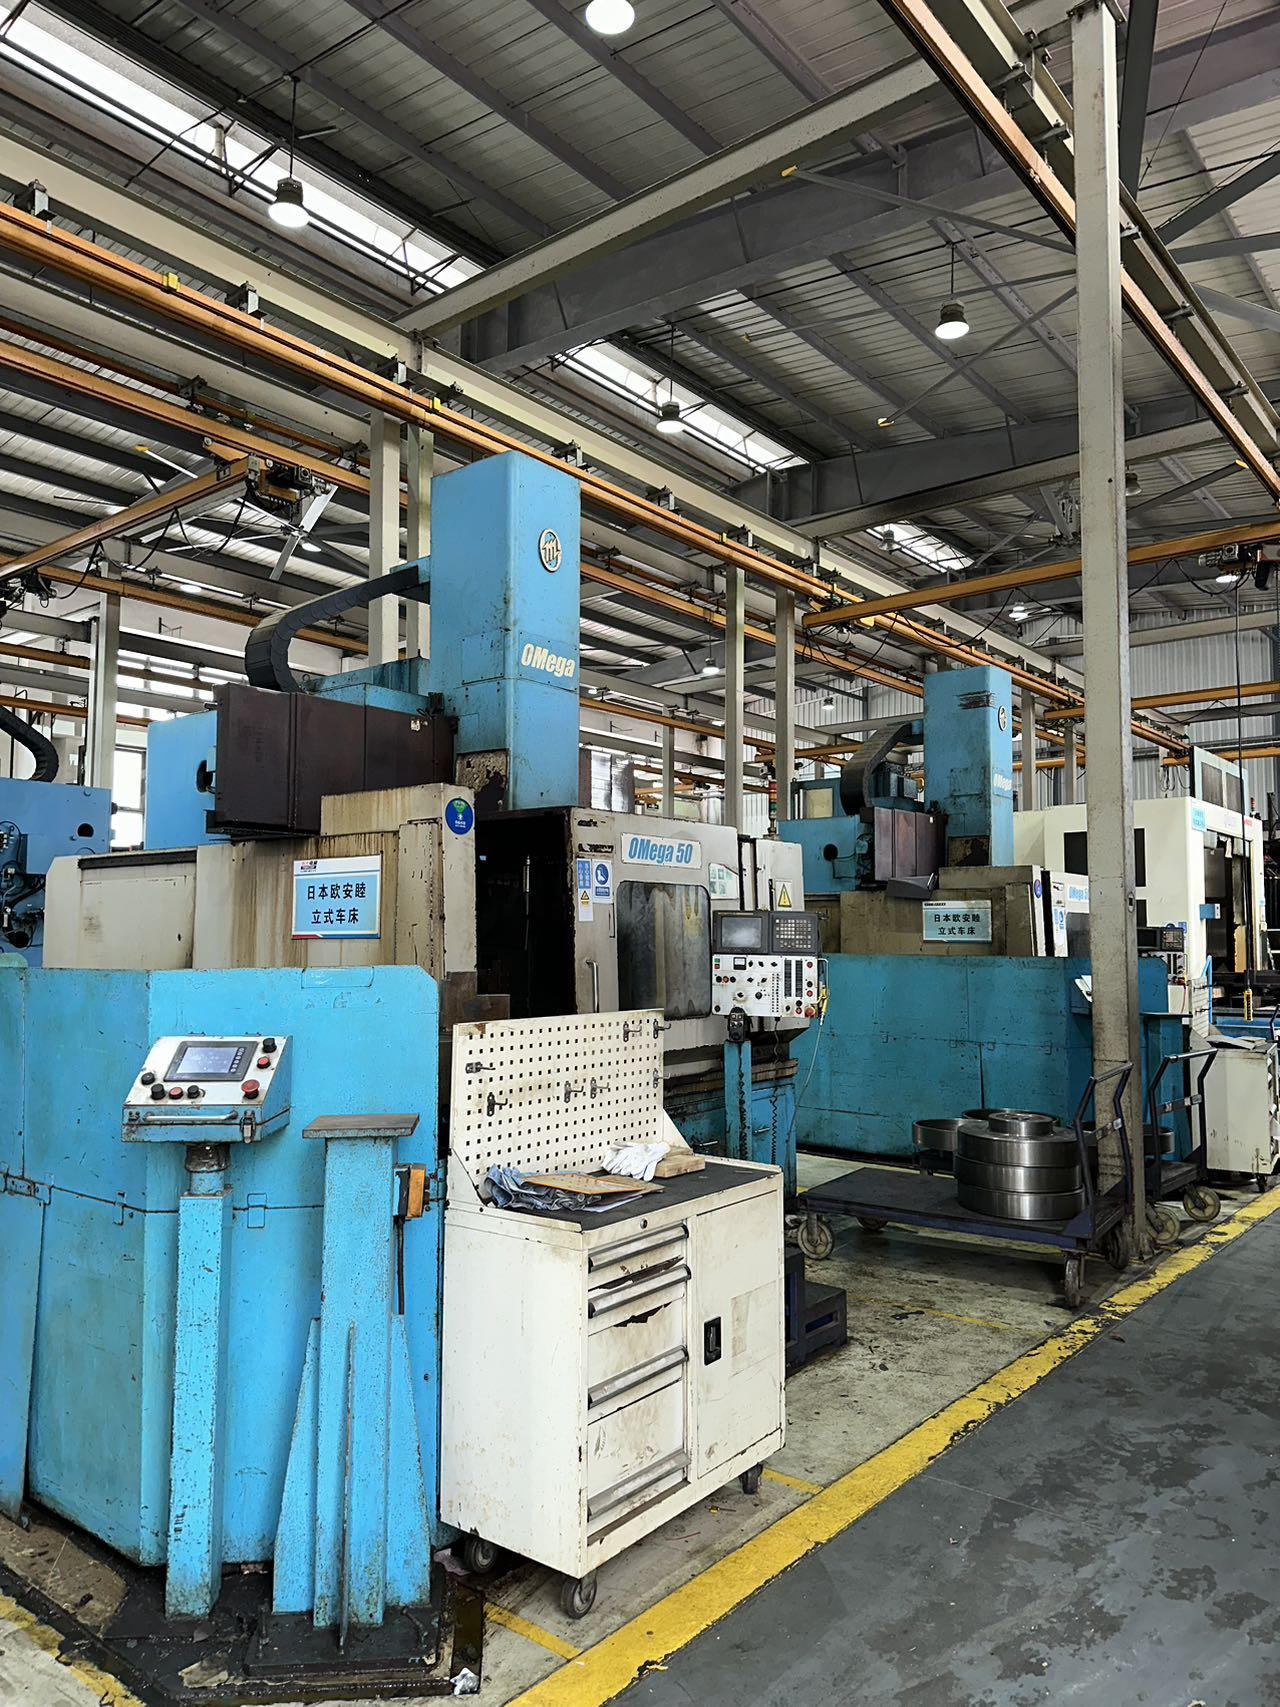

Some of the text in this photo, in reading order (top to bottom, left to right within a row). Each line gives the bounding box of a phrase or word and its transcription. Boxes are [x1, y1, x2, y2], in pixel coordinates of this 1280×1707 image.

[521, 643, 576, 678] OMega
[628, 837, 693, 864] OMega 50
[307, 882, 366, 900] 日本欧安睦
[311, 907, 359, 924] 立式车床
[938, 926, 976, 936] 立式车床
